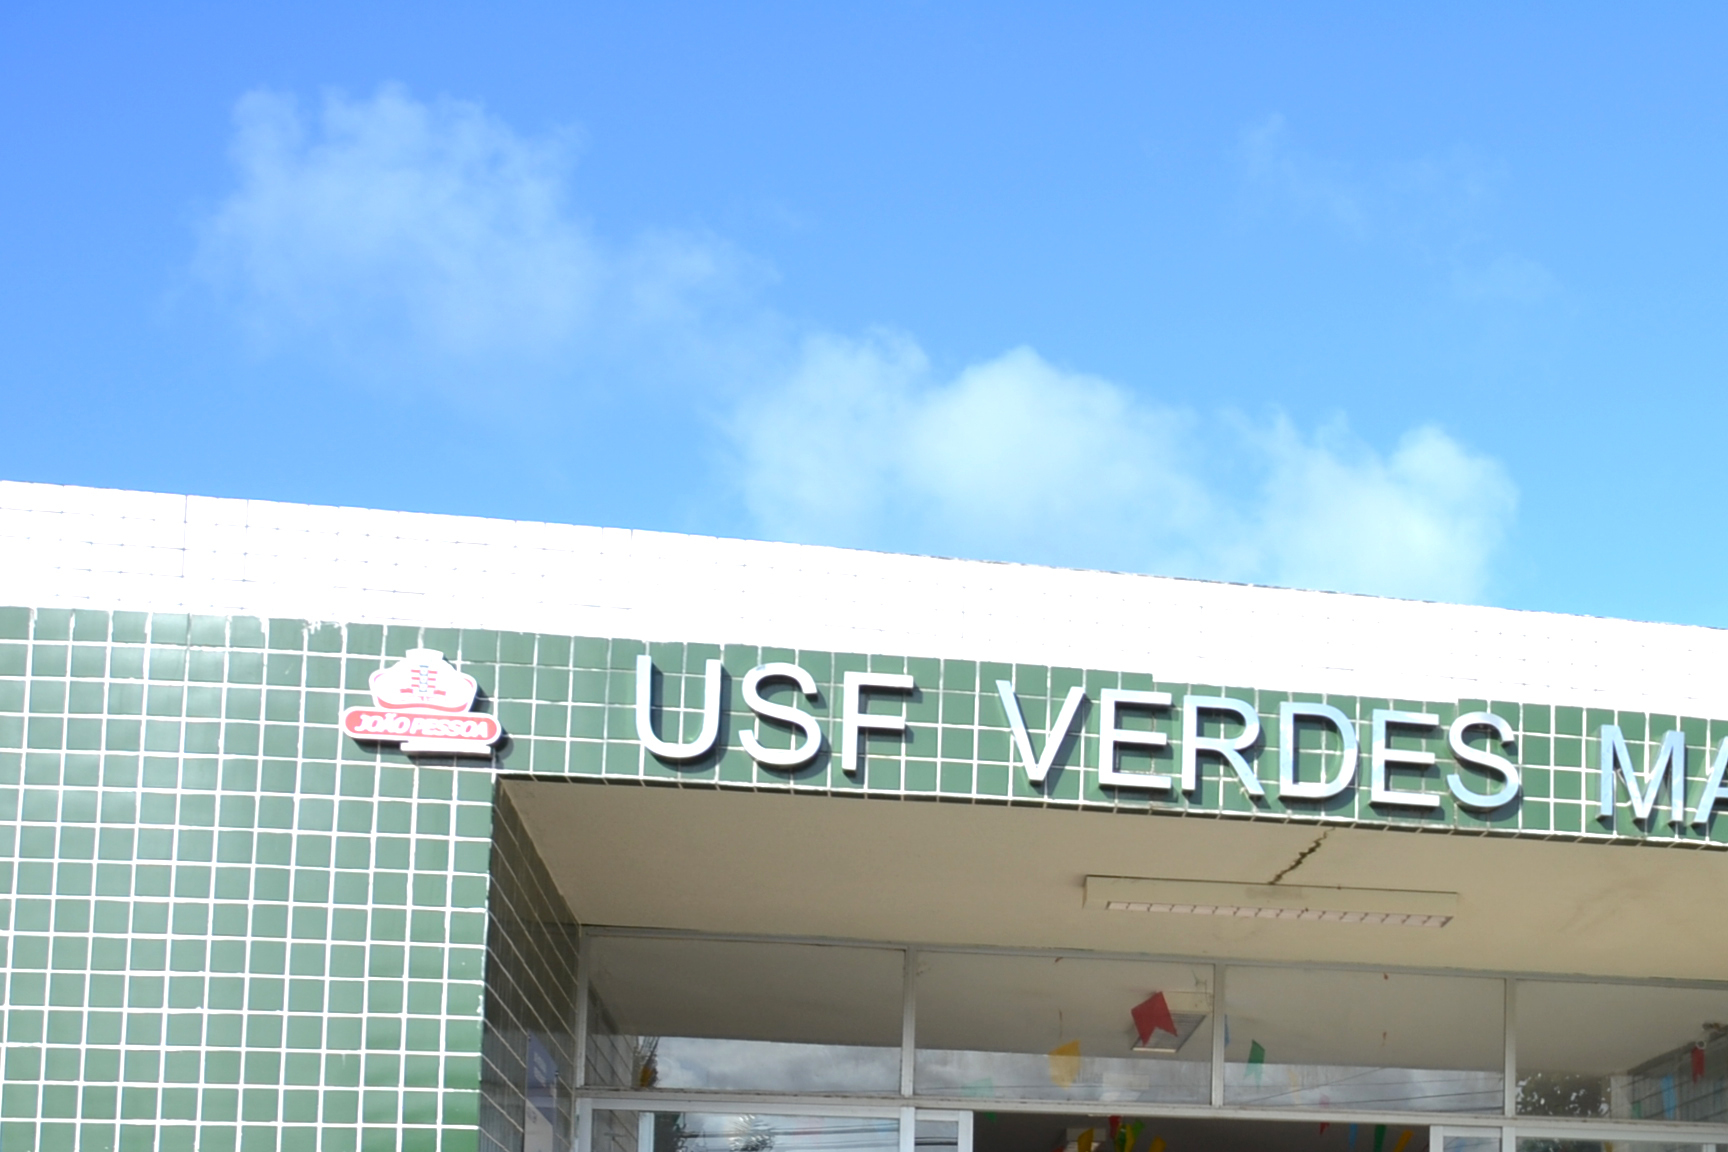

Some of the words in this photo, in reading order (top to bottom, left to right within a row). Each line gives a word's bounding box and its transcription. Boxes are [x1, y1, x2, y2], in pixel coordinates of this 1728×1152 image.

[354, 712, 411, 734] JOÃO
[409, 717, 488, 738] PESSOA
[633, 653, 913, 773] USF
[995, 679, 1521, 812] VERDES
